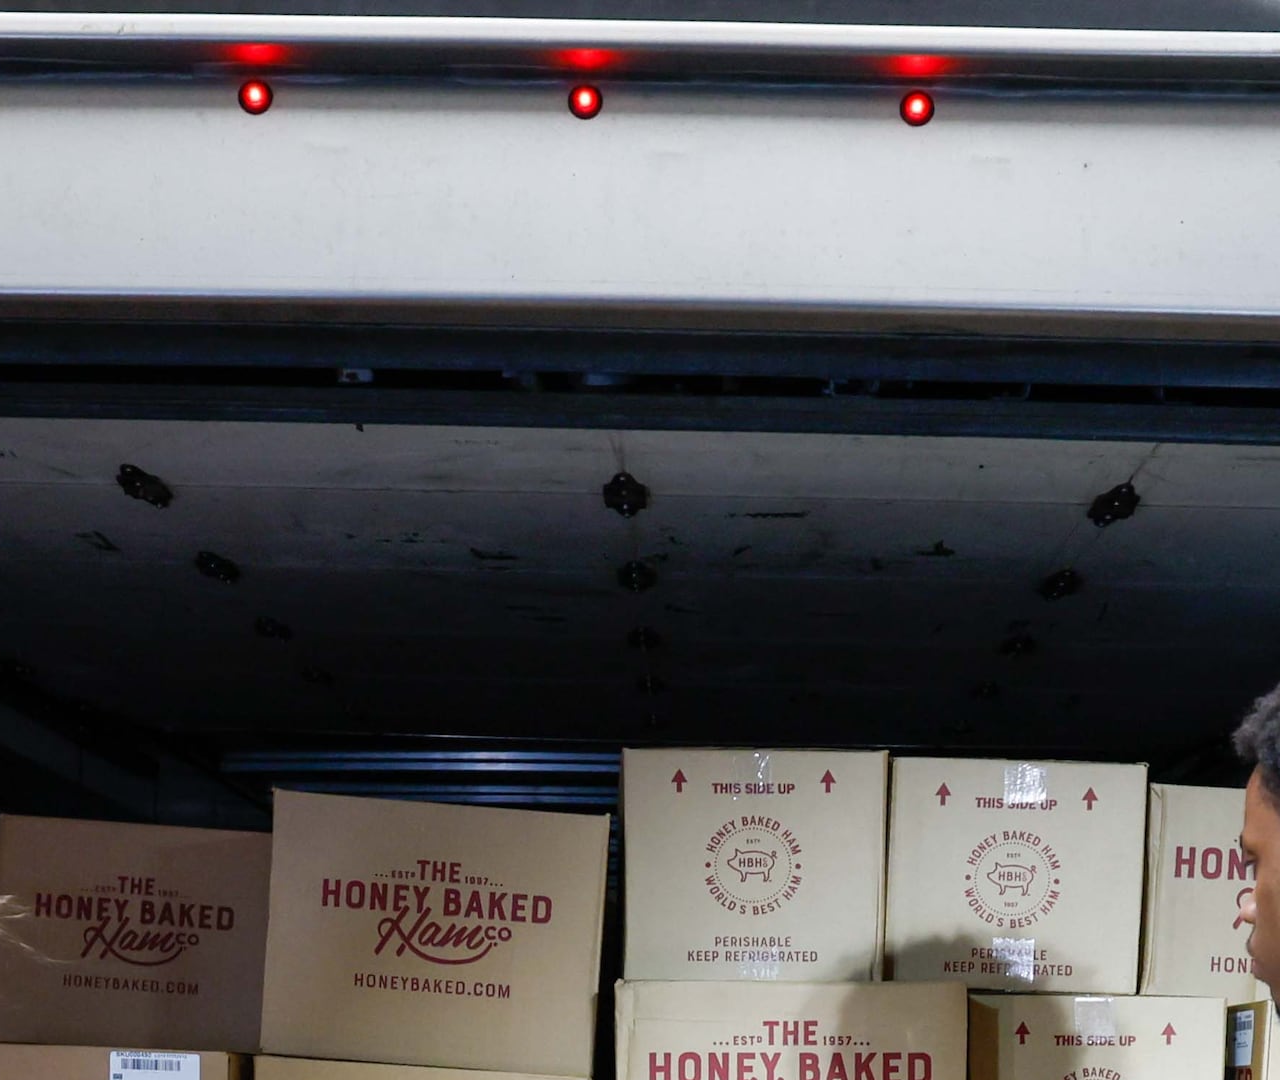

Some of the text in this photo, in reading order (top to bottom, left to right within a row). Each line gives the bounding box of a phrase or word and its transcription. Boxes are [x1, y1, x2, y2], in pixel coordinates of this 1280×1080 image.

[712, 783, 796, 794] THIS SIDE UP
[976, 797, 1004, 809] THIS
[1040, 799, 1058, 811] UP
[706, 815, 802, 856] HONEY BAKED HAM
[966, 830, 1061, 870] HONEY BAKED HAM
[417, 860, 462, 884] THE
[117, 876, 156, 897] THE
[753, 899, 782, 915] BEST
[783, 875, 802, 900] HAM
[34, 893, 235, 932] HONEY BAKED
[321, 878, 553, 925] HONEY BAKED
[1010, 913, 1039, 929] BEST
[1040, 891, 1060, 915] HAM
[374, 905, 513, 965] Ham CO
[715, 936, 792, 948] PERISHABLE
[688, 951, 818, 962] KEEP REFRIGERATED
[944, 961, 975, 973] KEEP
[63, 974, 199, 996] HONEYBAKED.COM
[354, 973, 511, 999] HONEYBAKED.COM
[762, 1020, 819, 1046] THE
[1054, 1035, 1136, 1046] THIS SIDE UP
